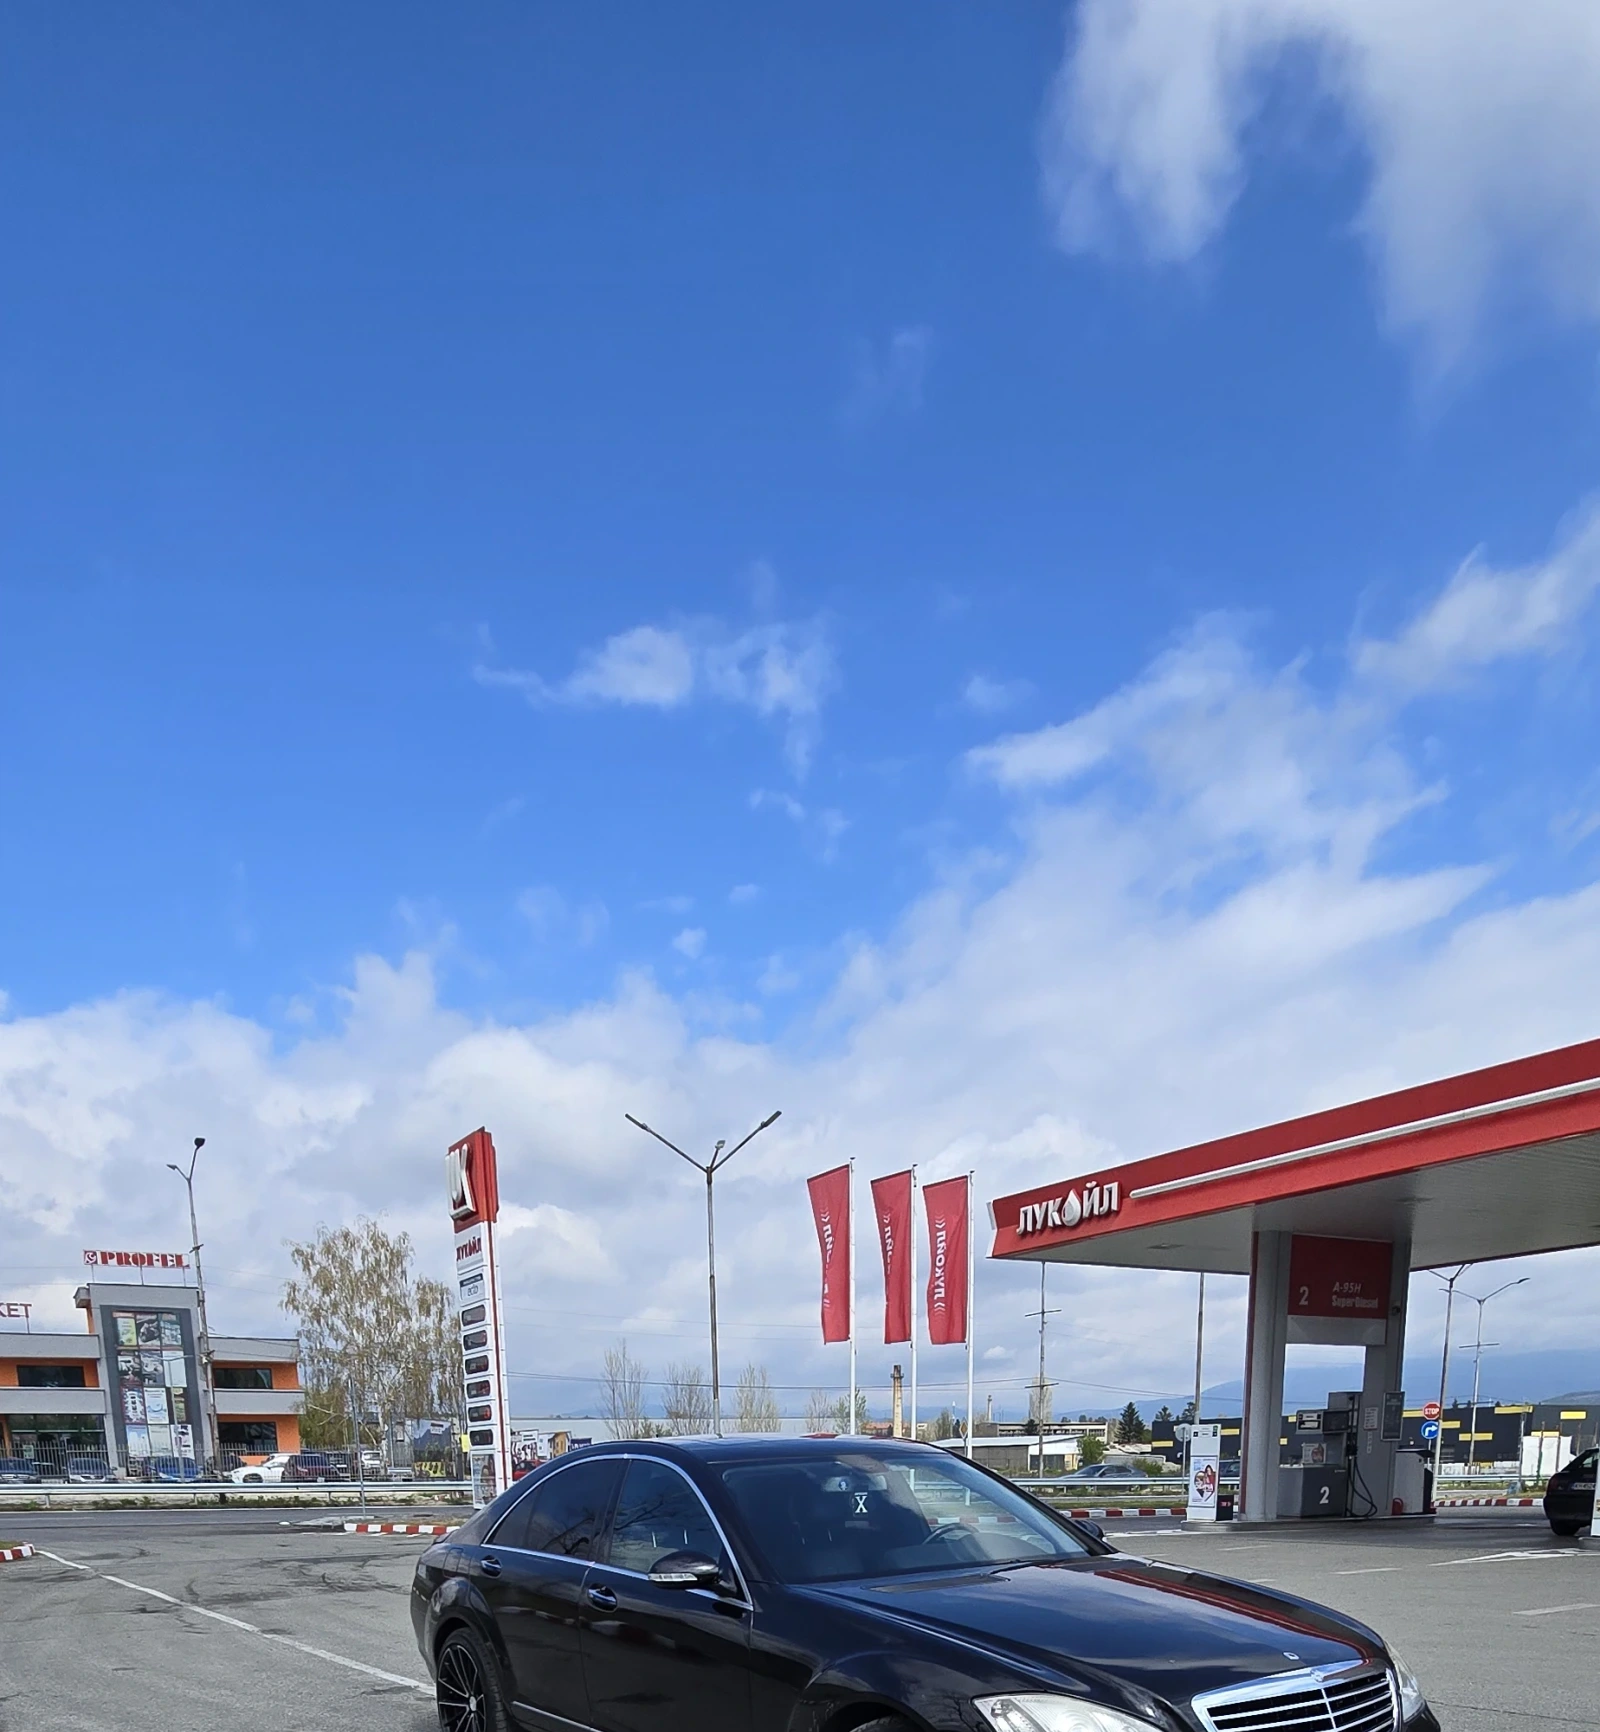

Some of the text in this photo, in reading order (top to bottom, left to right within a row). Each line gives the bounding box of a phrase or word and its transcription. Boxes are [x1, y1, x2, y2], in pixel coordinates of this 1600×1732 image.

[100, 1251, 190, 1269] PROFEL
[1299, 1286, 1309, 1305] 2
[1424, 1407, 1440, 1415] STOP
[1319, 1486, 1330, 1504] 2
